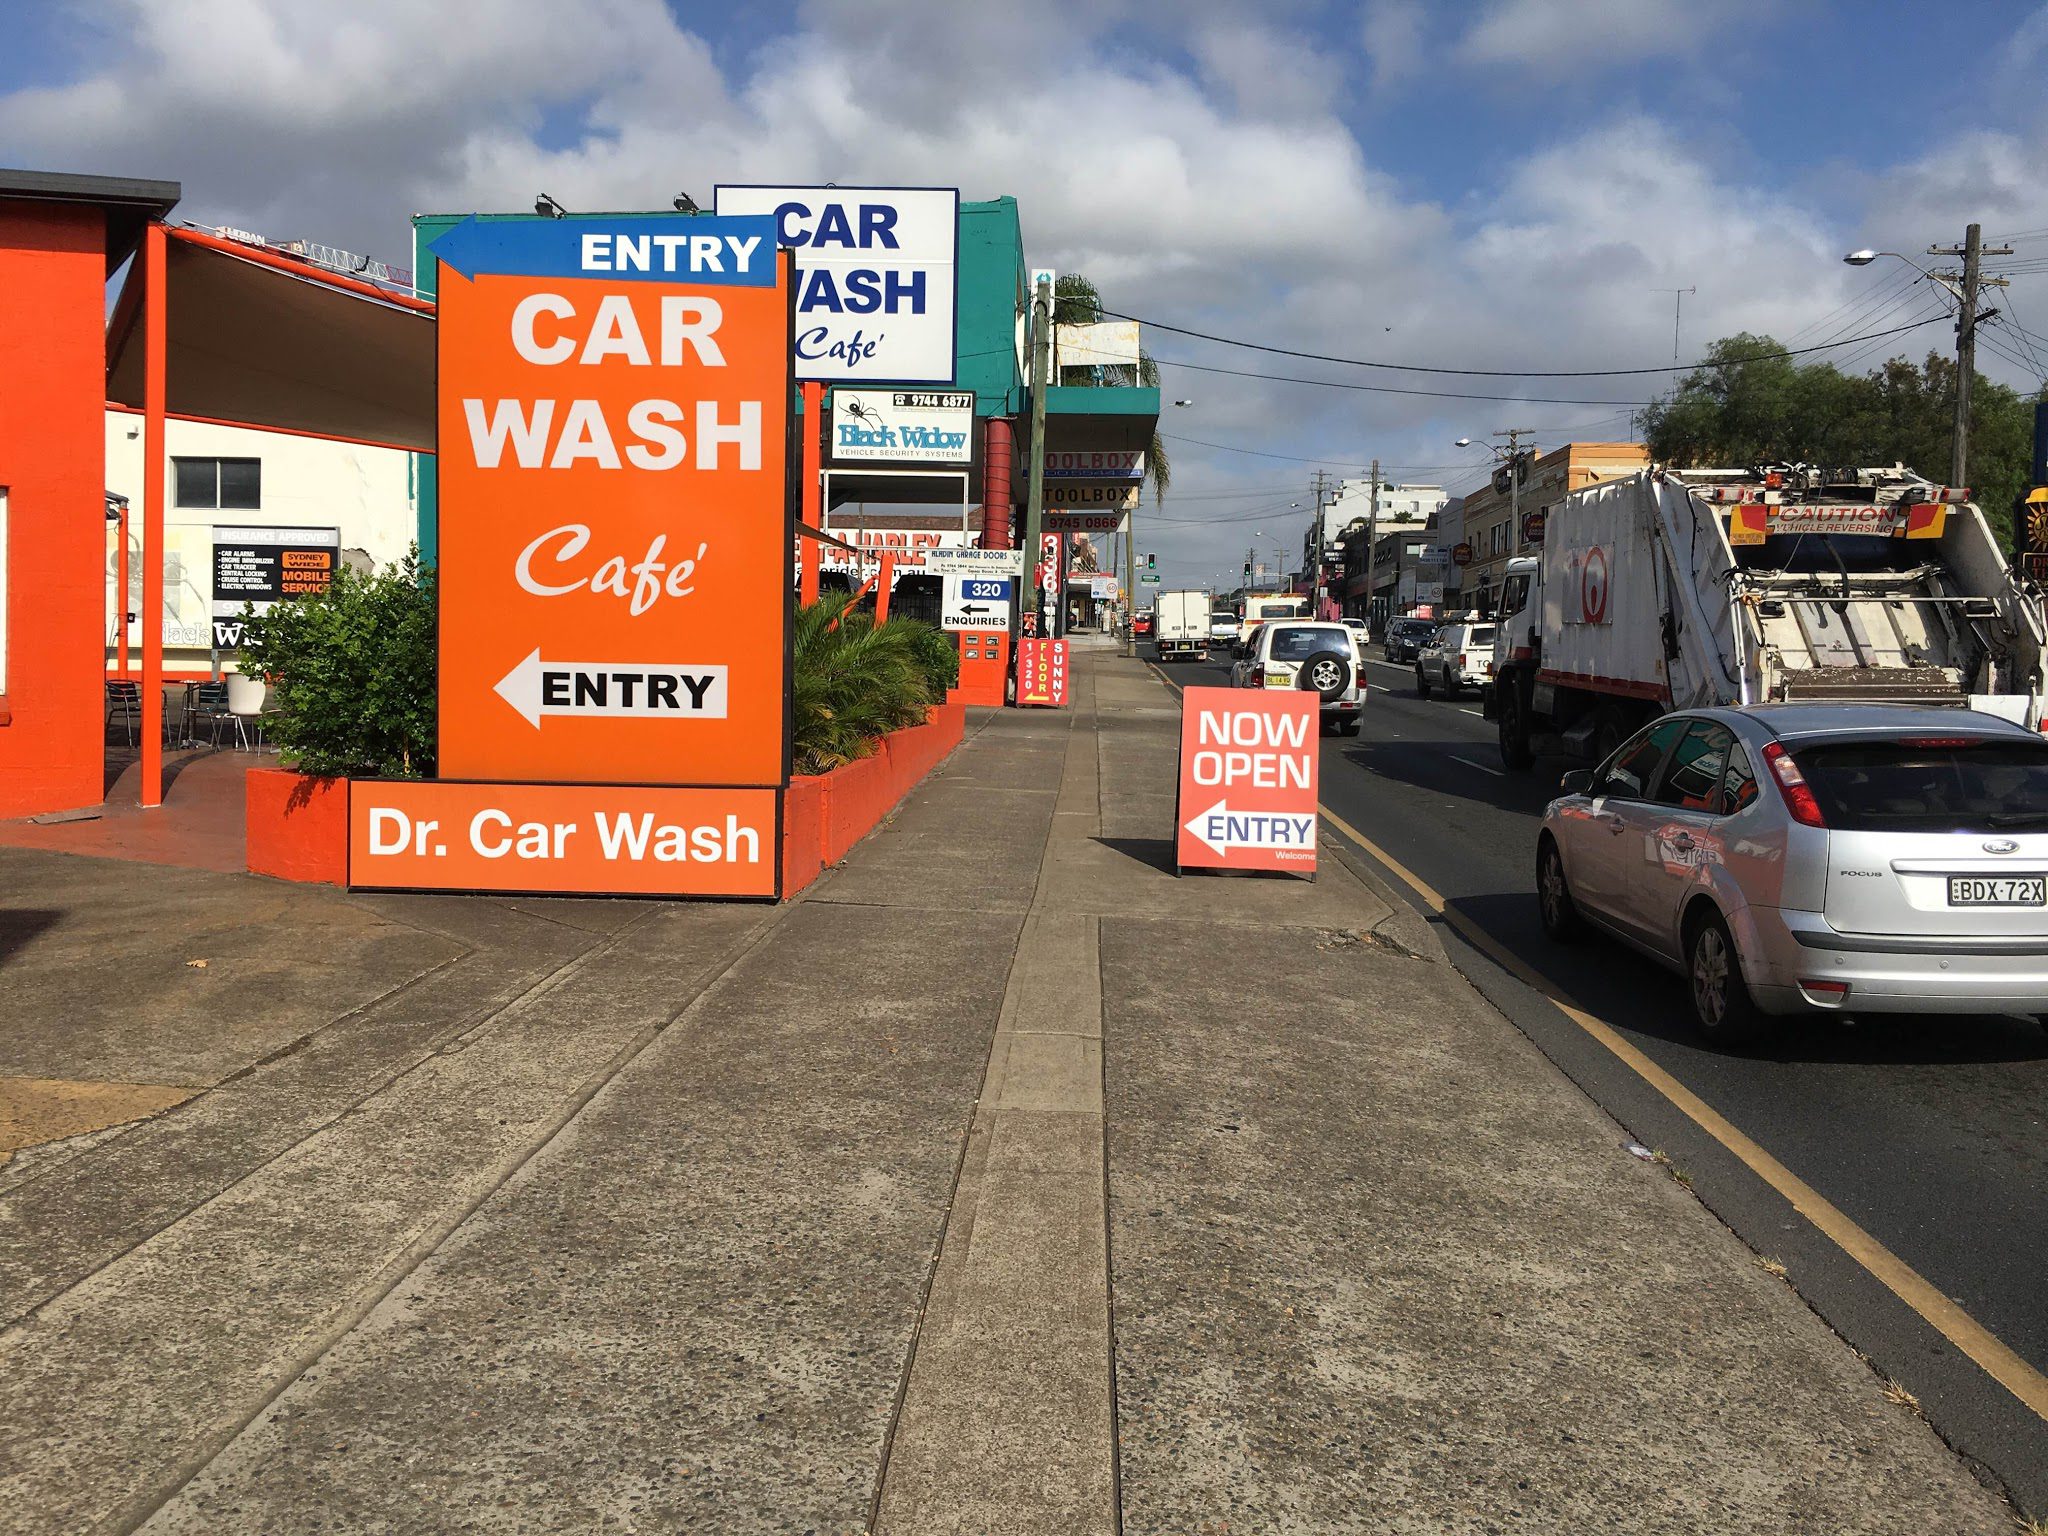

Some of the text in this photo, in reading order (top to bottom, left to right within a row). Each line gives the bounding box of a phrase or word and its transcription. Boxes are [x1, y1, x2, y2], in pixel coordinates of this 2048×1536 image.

[775, 202, 900, 249] CAR
[581, 234, 762, 273] ENTRY
[795, 269, 927, 315] ASH
[511, 293, 728, 367] CAR
[911, 394, 970, 407] 9744 6877
[462, 398, 762, 471] WASH
[837, 424, 967, 449] Black Widow
[1044, 452, 1136, 469] OOLBOX
[1042, 488, 1130, 502] TOOLBOX
[1779, 507, 1897, 522] CAUTION
[1049, 517, 1118, 529] 9745 0866
[1775, 523, 1893, 534] VEHICLE REVERSING
[220, 531, 329, 542] INSURANCE APPROVED
[287, 553, 325, 561] SYDNEY
[956, 551, 981, 559] GARAGE
[983, 552, 1007, 560] DOORS
[282, 571, 331, 582] MOBILE
[971, 582, 1001, 597] 320
[944, 616, 1006, 626] ENQUIRIES
[542, 671, 716, 710] ENTRY
[1199, 710, 1311, 748] NOW
[1192, 751, 1311, 789] OPEN
[368, 807, 760, 864] Dr. Car Wash
[1206, 815, 1313, 844] ENTRY
[1274, 850, 1315, 861] Welcome
[1840, 870, 1882, 878] FOCUS
